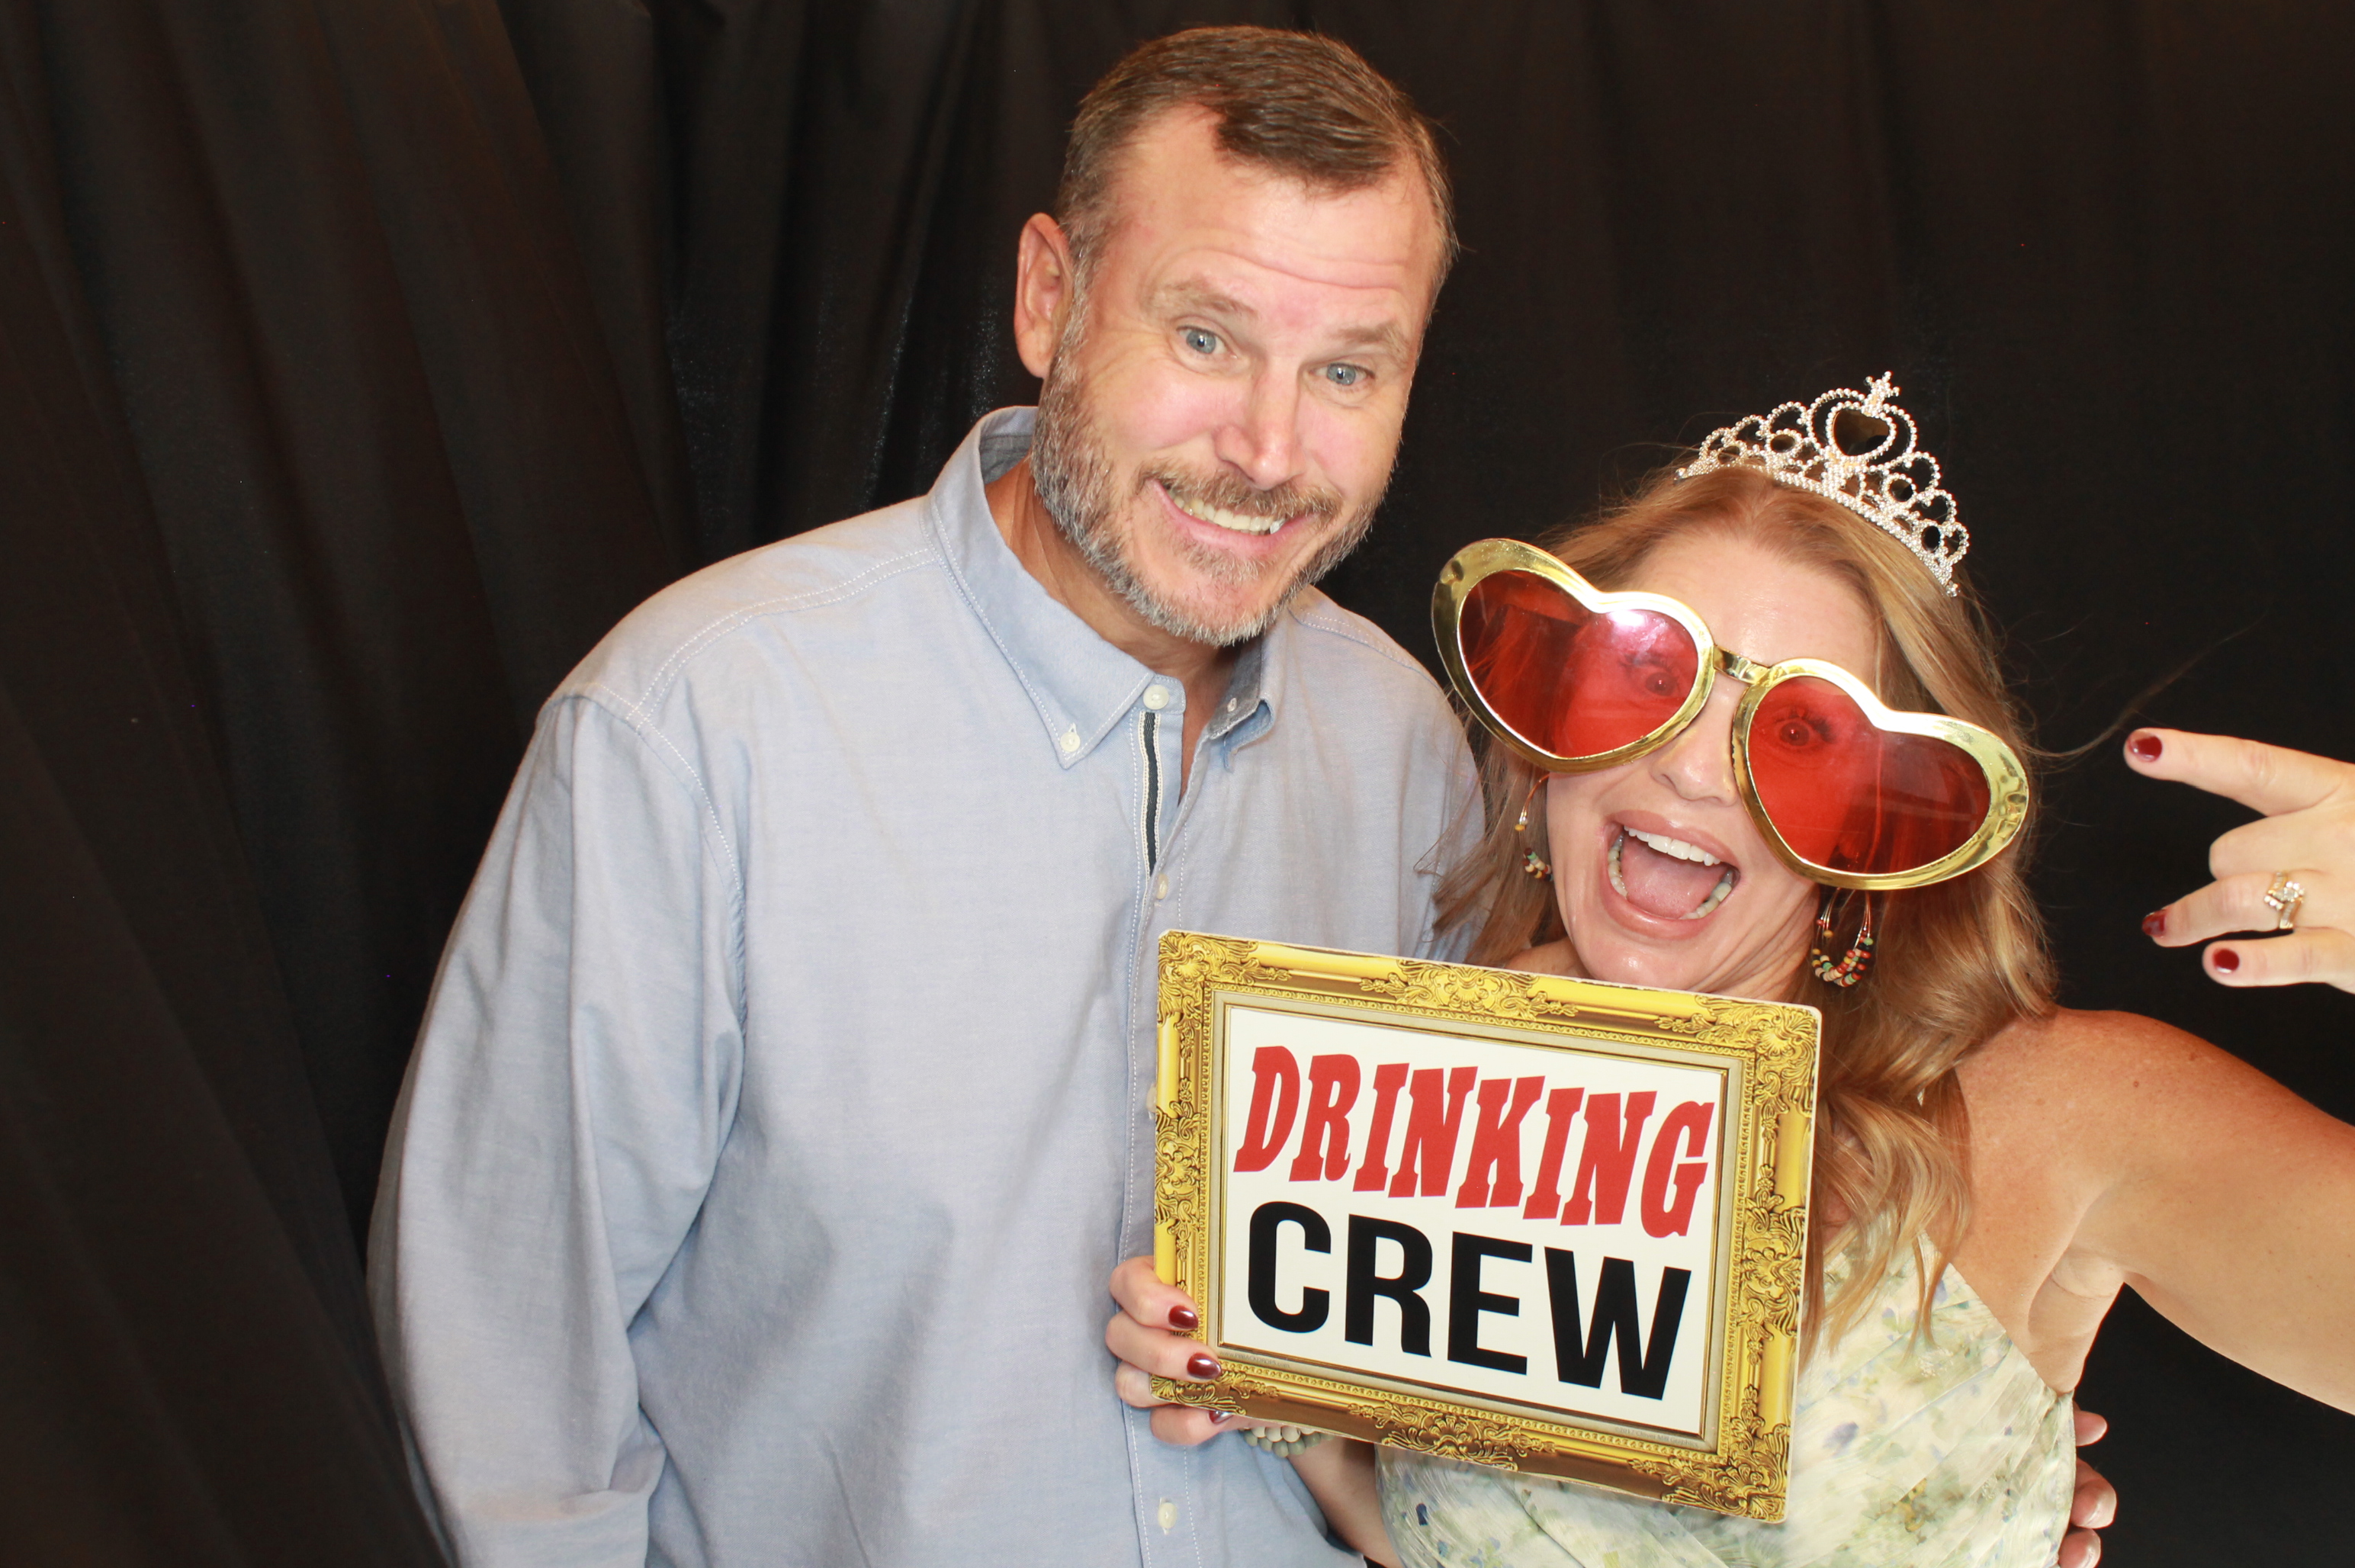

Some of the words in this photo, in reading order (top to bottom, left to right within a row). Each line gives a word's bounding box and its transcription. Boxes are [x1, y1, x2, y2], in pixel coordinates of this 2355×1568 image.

[1234, 1046, 1715, 1239] DRINKING
[1248, 1202, 1692, 1400] CREW
[1670, 1436, 1698, 1448] Graphics
